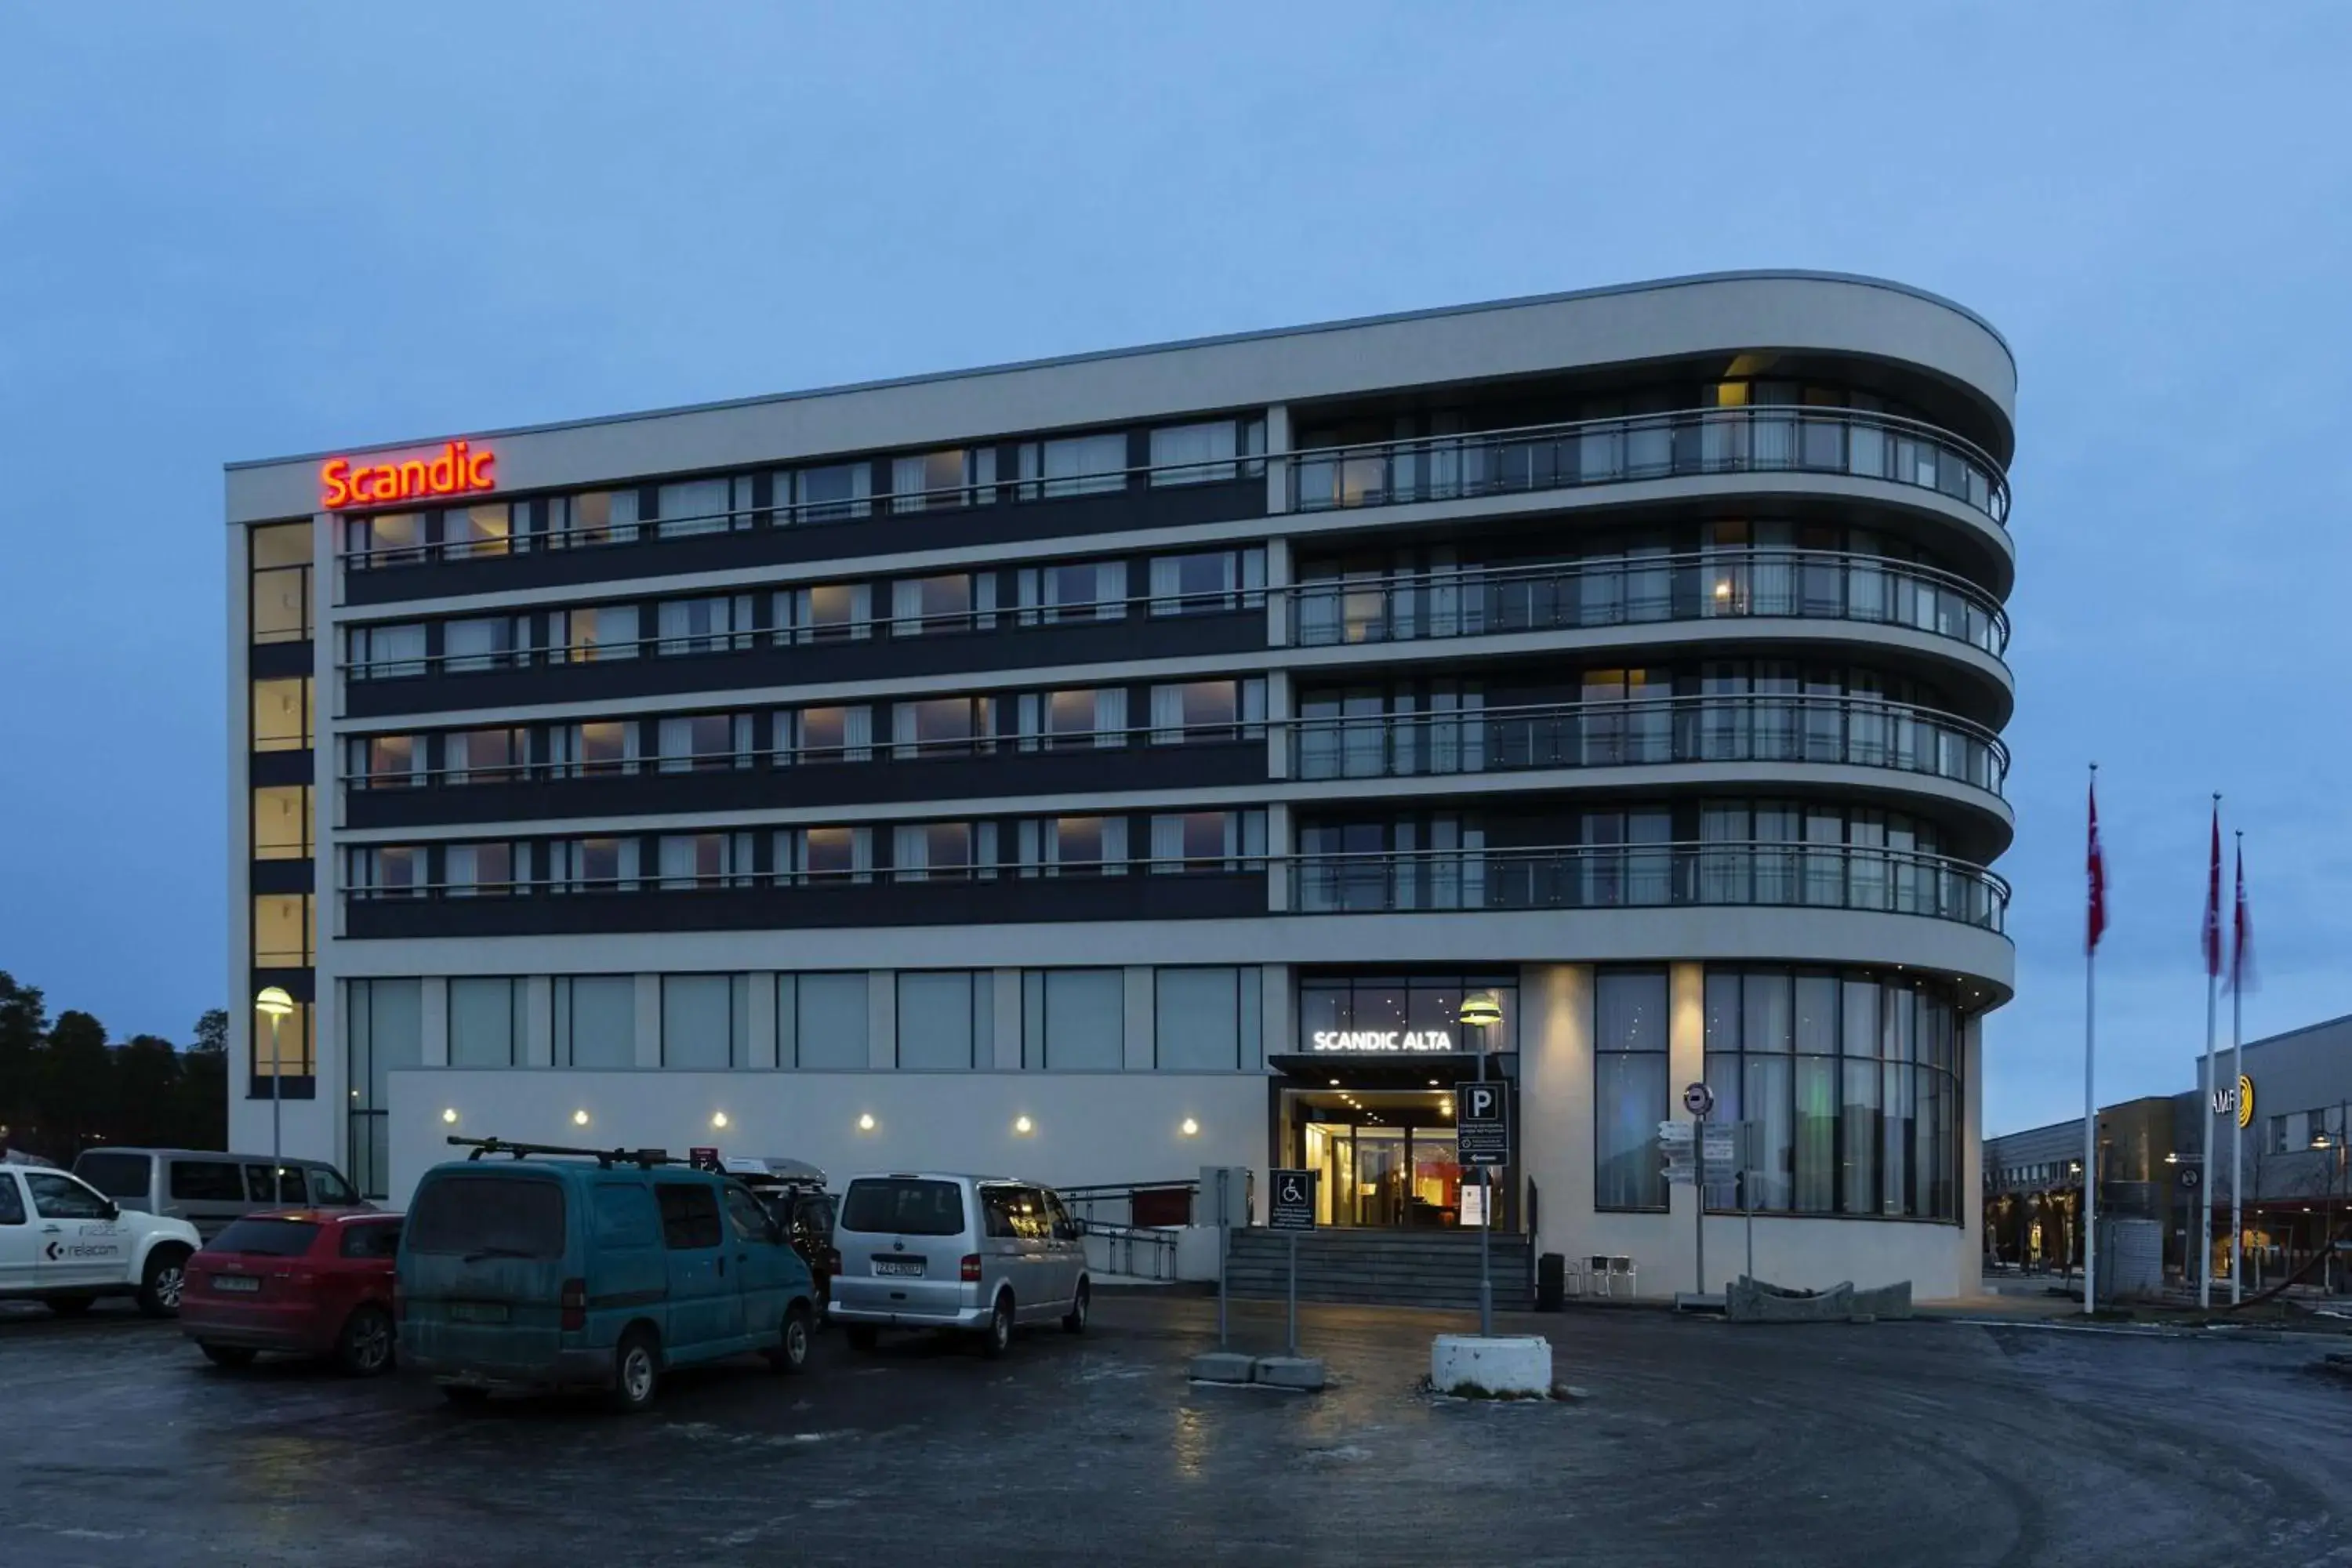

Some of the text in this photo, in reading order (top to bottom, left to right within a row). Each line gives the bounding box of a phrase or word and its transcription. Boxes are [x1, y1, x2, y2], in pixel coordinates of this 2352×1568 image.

[322, 440, 493, 507] Scandic
[1314, 1031, 1451, 1050] SCANDIC ALTA
[1474, 1090, 1492, 1117] P
